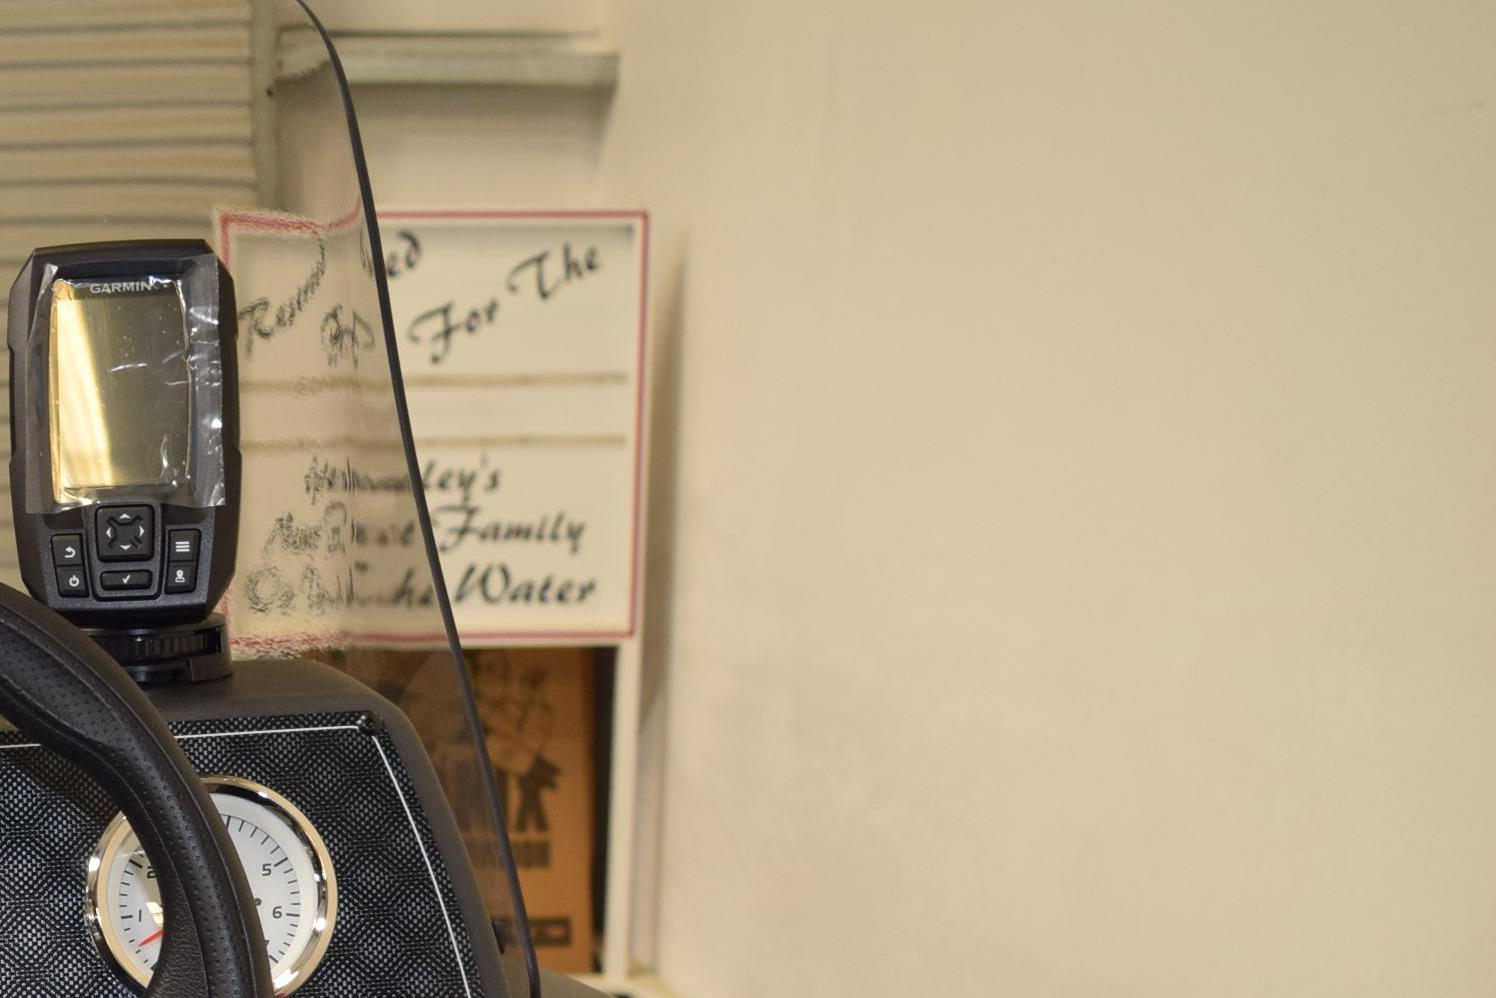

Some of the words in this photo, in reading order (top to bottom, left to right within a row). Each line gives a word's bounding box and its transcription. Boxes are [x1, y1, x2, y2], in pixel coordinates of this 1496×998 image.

[90, 281, 152, 294] GARMIN
[407, 300, 499, 364] For
[507, 242, 599, 300] The
[434, 505, 586, 556] Family
[455, 563, 596, 604] Water
[262, 863, 272, 876] 5
[272, 906, 282, 919] 6
